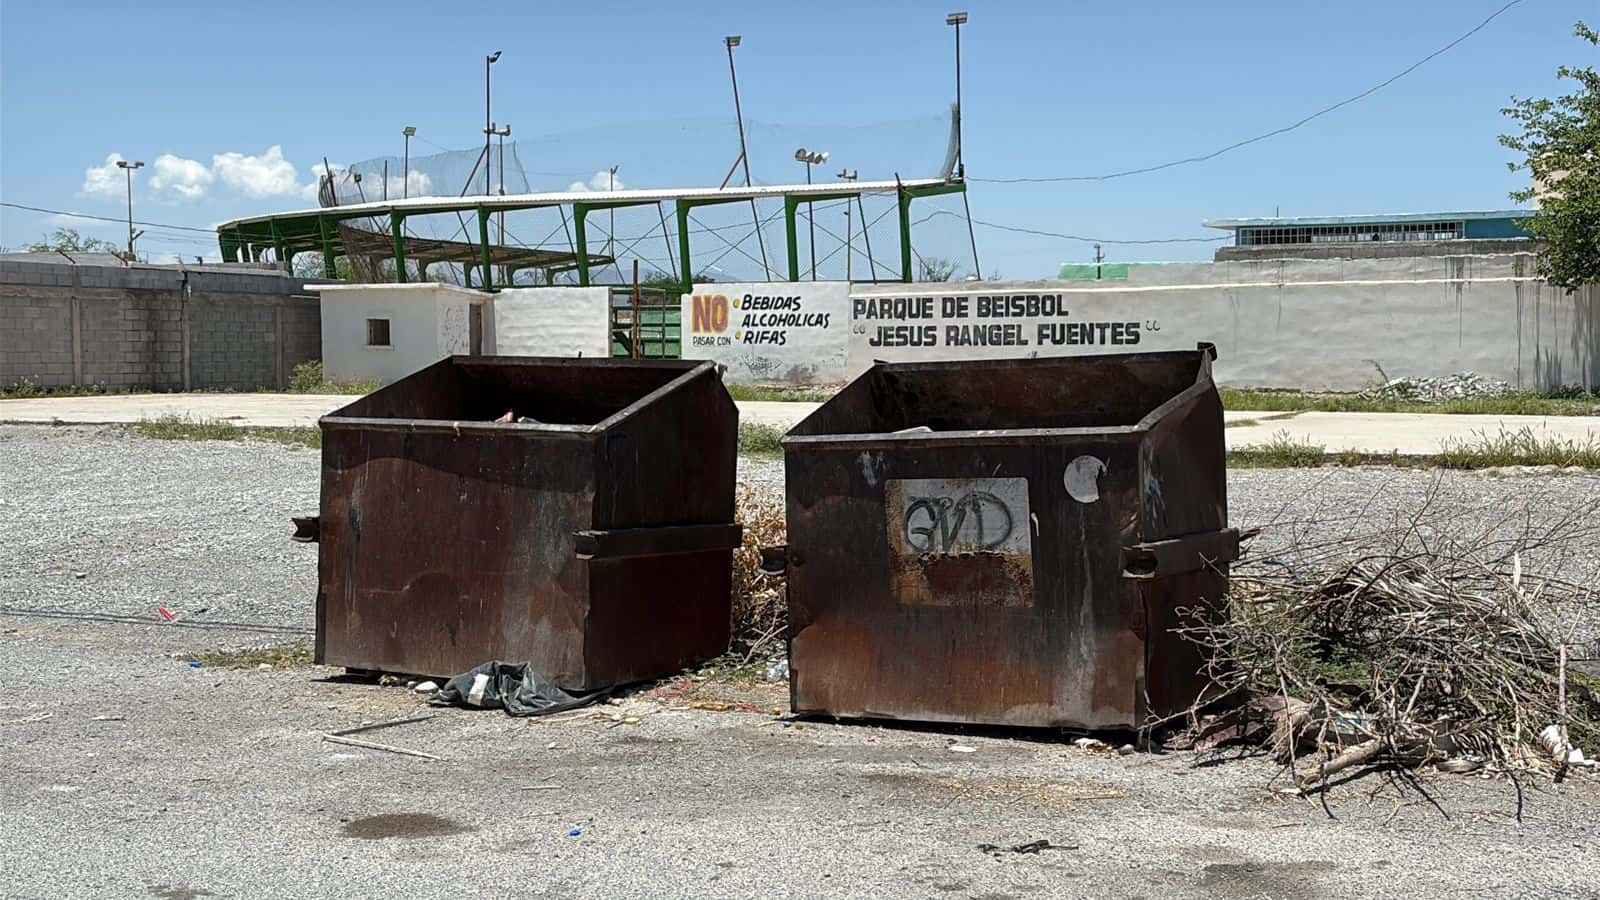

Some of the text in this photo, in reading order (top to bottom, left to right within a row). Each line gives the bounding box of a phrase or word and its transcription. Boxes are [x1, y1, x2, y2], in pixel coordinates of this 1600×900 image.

[741, 294, 801, 311] BEBIDAS
[853, 294, 1069, 320] PARQUE DE BEISBOL
[692, 295, 729, 333] NO
[741, 313, 830, 329] ALCOHOLICAS
[692, 335, 731, 346] PASAR CON
[743, 330, 787, 346] RIFAS
[945, 323, 1029, 346] RANGEL
